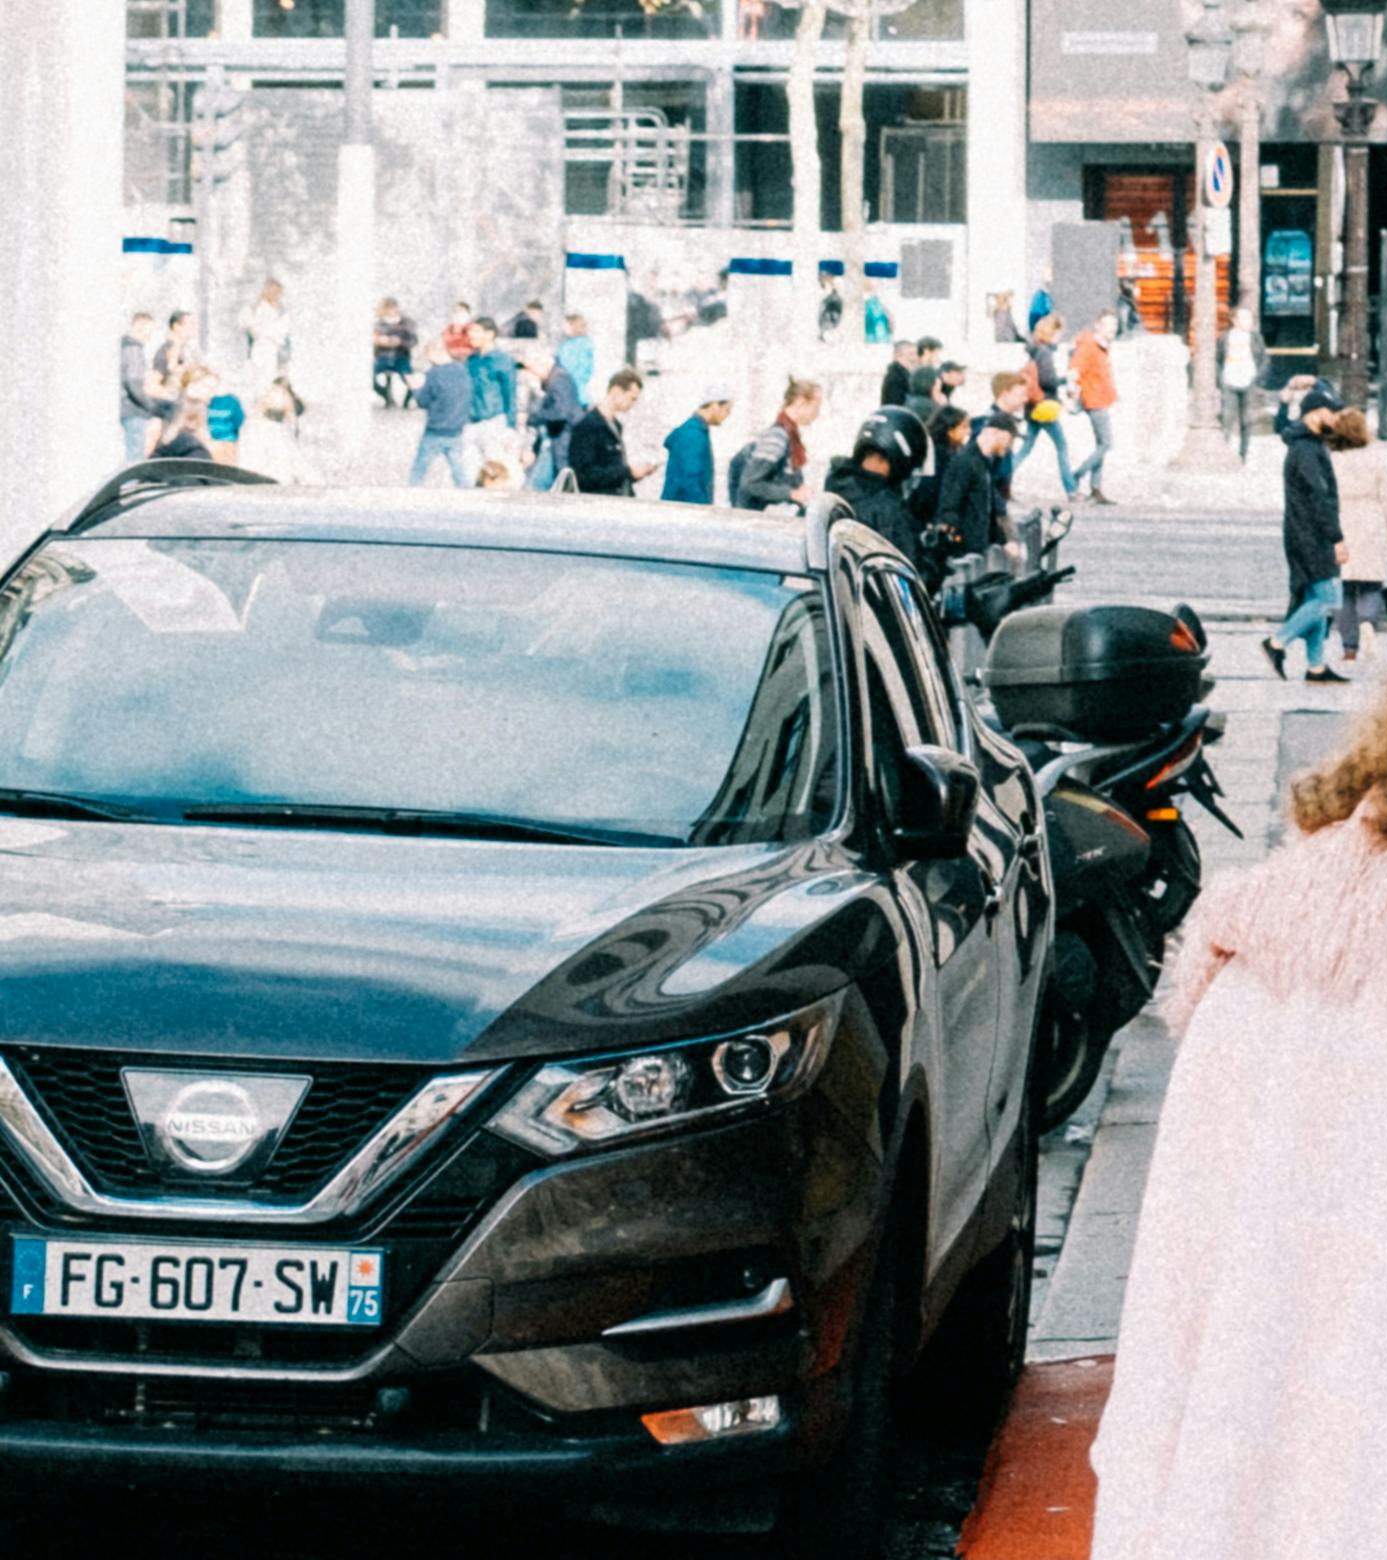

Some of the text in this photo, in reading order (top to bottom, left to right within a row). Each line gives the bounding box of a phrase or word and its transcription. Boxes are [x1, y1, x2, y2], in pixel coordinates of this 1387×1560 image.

[167, 1117, 255, 1136] NISSAN
[23, 1251, 379, 1317] F FG-607-SW 75
